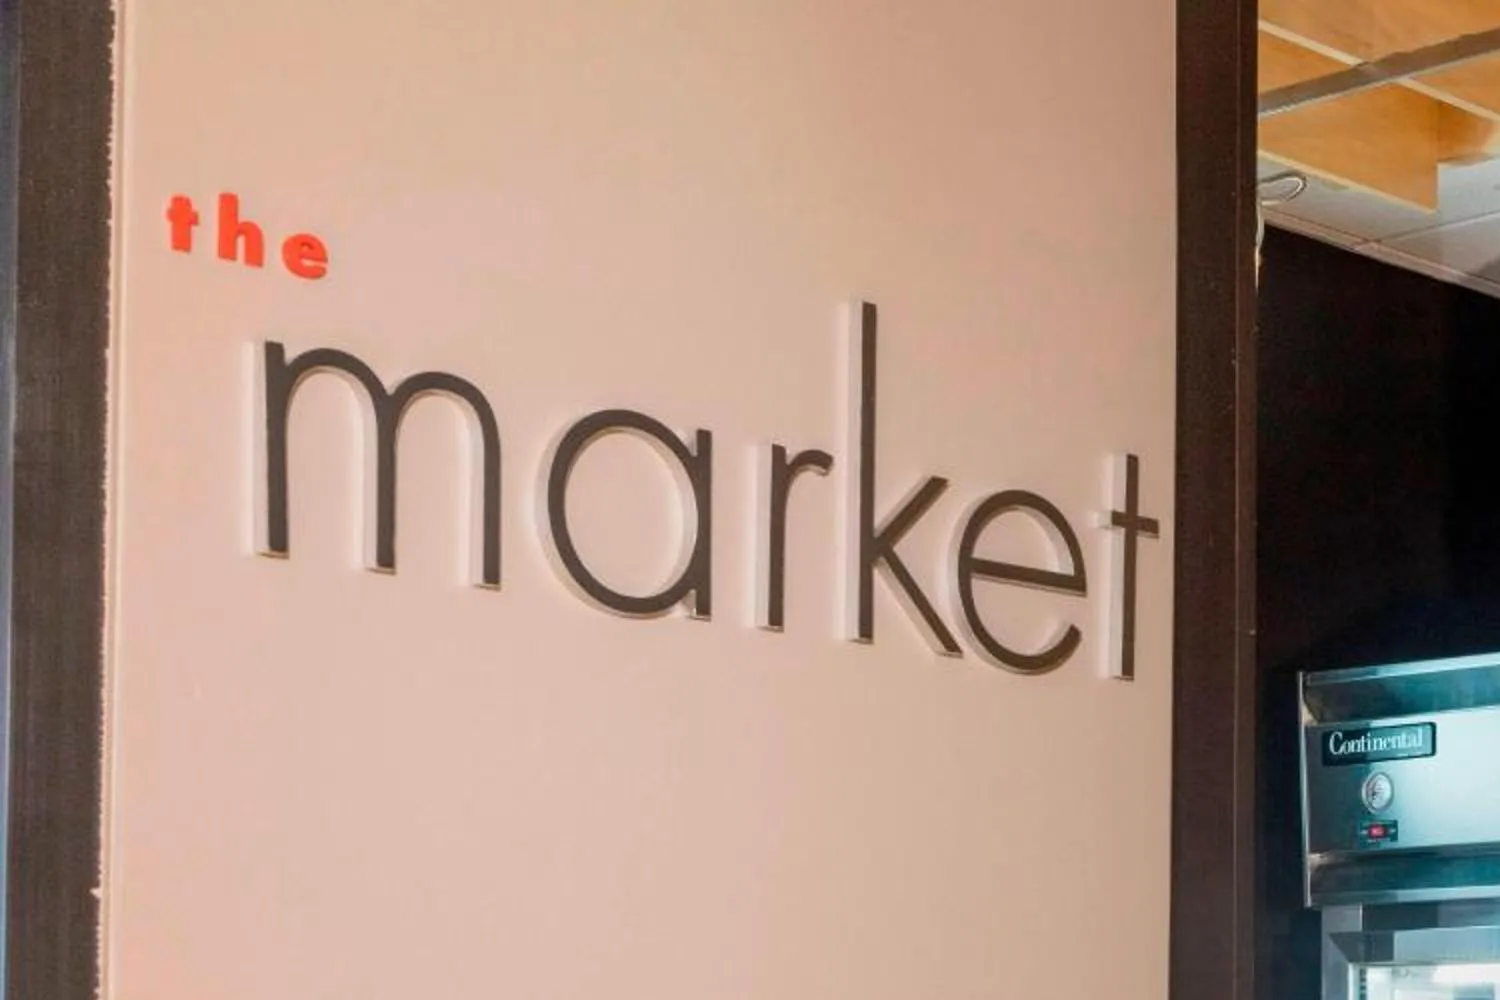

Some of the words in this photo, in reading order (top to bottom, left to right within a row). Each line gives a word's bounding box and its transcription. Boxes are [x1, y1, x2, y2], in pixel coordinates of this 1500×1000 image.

[167, 192, 330, 279] the
[246, 300, 1160, 683] market
[1328, 727, 1424, 755] Continental
